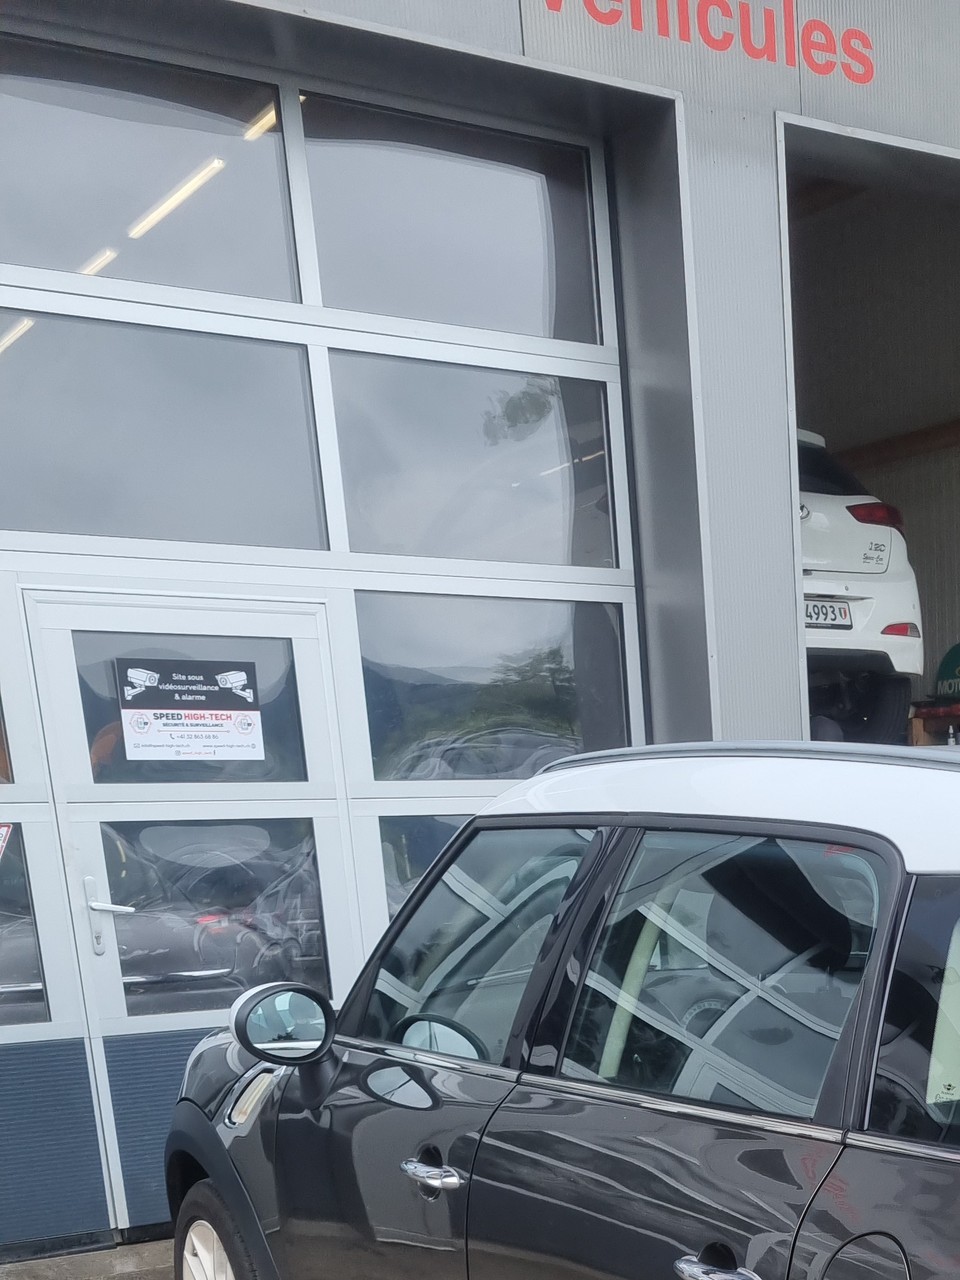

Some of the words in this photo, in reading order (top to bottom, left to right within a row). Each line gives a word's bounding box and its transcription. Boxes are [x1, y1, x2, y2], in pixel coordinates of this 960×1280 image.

[158, 683, 220, 691] vidéosurveillance
[181, 693, 206, 701] alarme
[153, 713, 183, 721] SPEED
[184, 713, 232, 721] HIGH-TECH
